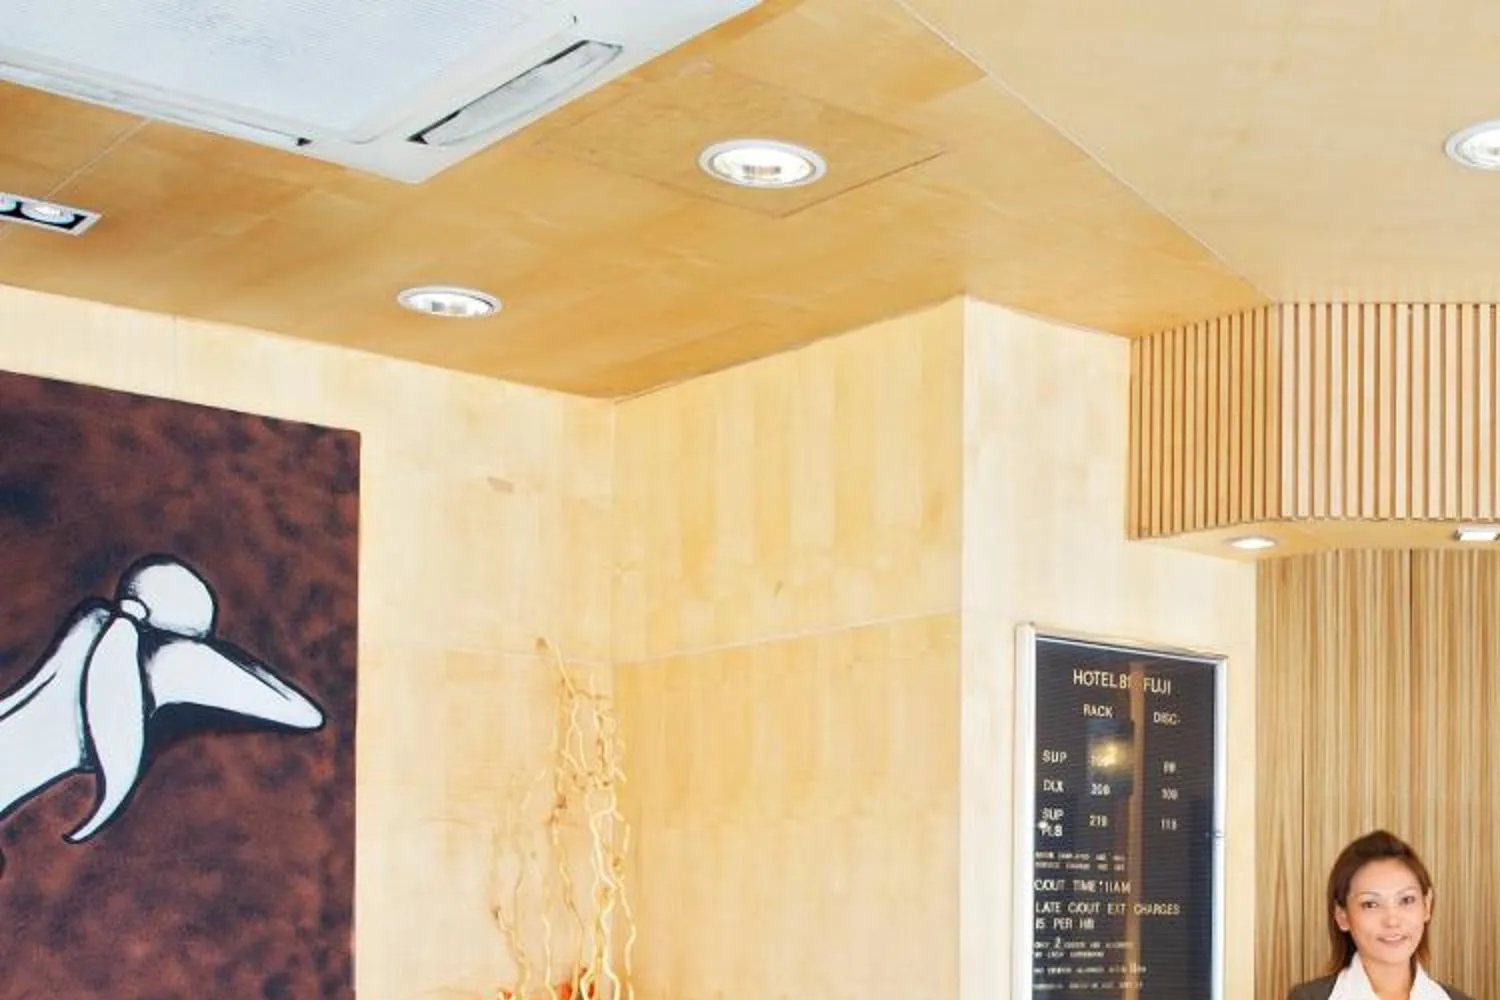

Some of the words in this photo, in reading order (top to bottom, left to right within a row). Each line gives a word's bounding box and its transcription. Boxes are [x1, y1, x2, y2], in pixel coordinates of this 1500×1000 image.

[1073, 669, 1117, 688] HOTEL
[1144, 677, 1171, 695] FUJI
[1083, 703, 1113, 718] RACK
[1042, 749, 1067, 763] SUP
[1035, 902, 1061, 913] LATE
[1053, 918, 1073, 929] PER
